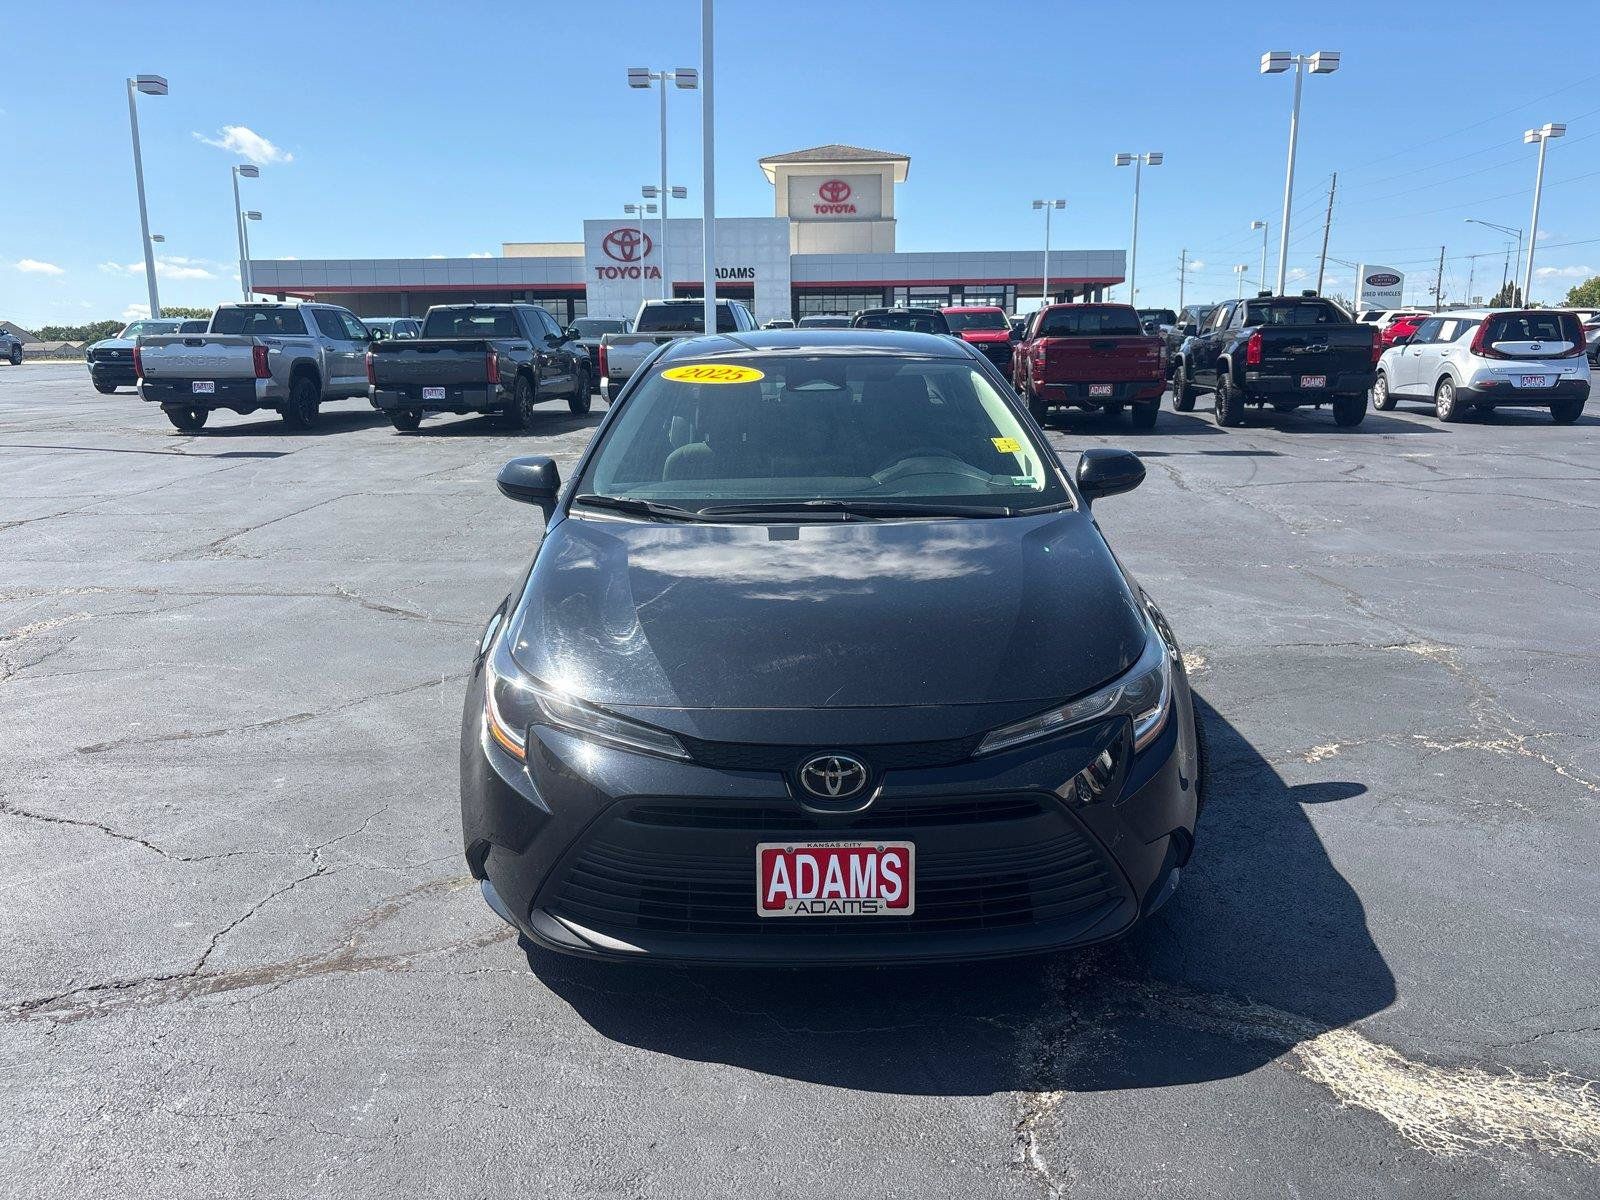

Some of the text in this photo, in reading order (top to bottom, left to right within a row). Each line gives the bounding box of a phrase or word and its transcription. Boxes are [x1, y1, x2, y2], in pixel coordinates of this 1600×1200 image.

[813, 203, 857, 214] TOYOTA
[594, 266, 662, 280] TOYOTA
[714, 267, 755, 279] ADAMS
[676, 367, 749, 381] 2025
[1302, 377, 1324, 386] ADAMS
[1523, 377, 1545, 385] ADAMS
[1090, 386, 1111, 395] ADAMS
[767, 853, 902, 903] ADAMS
[794, 900, 878, 914] ADAMS
